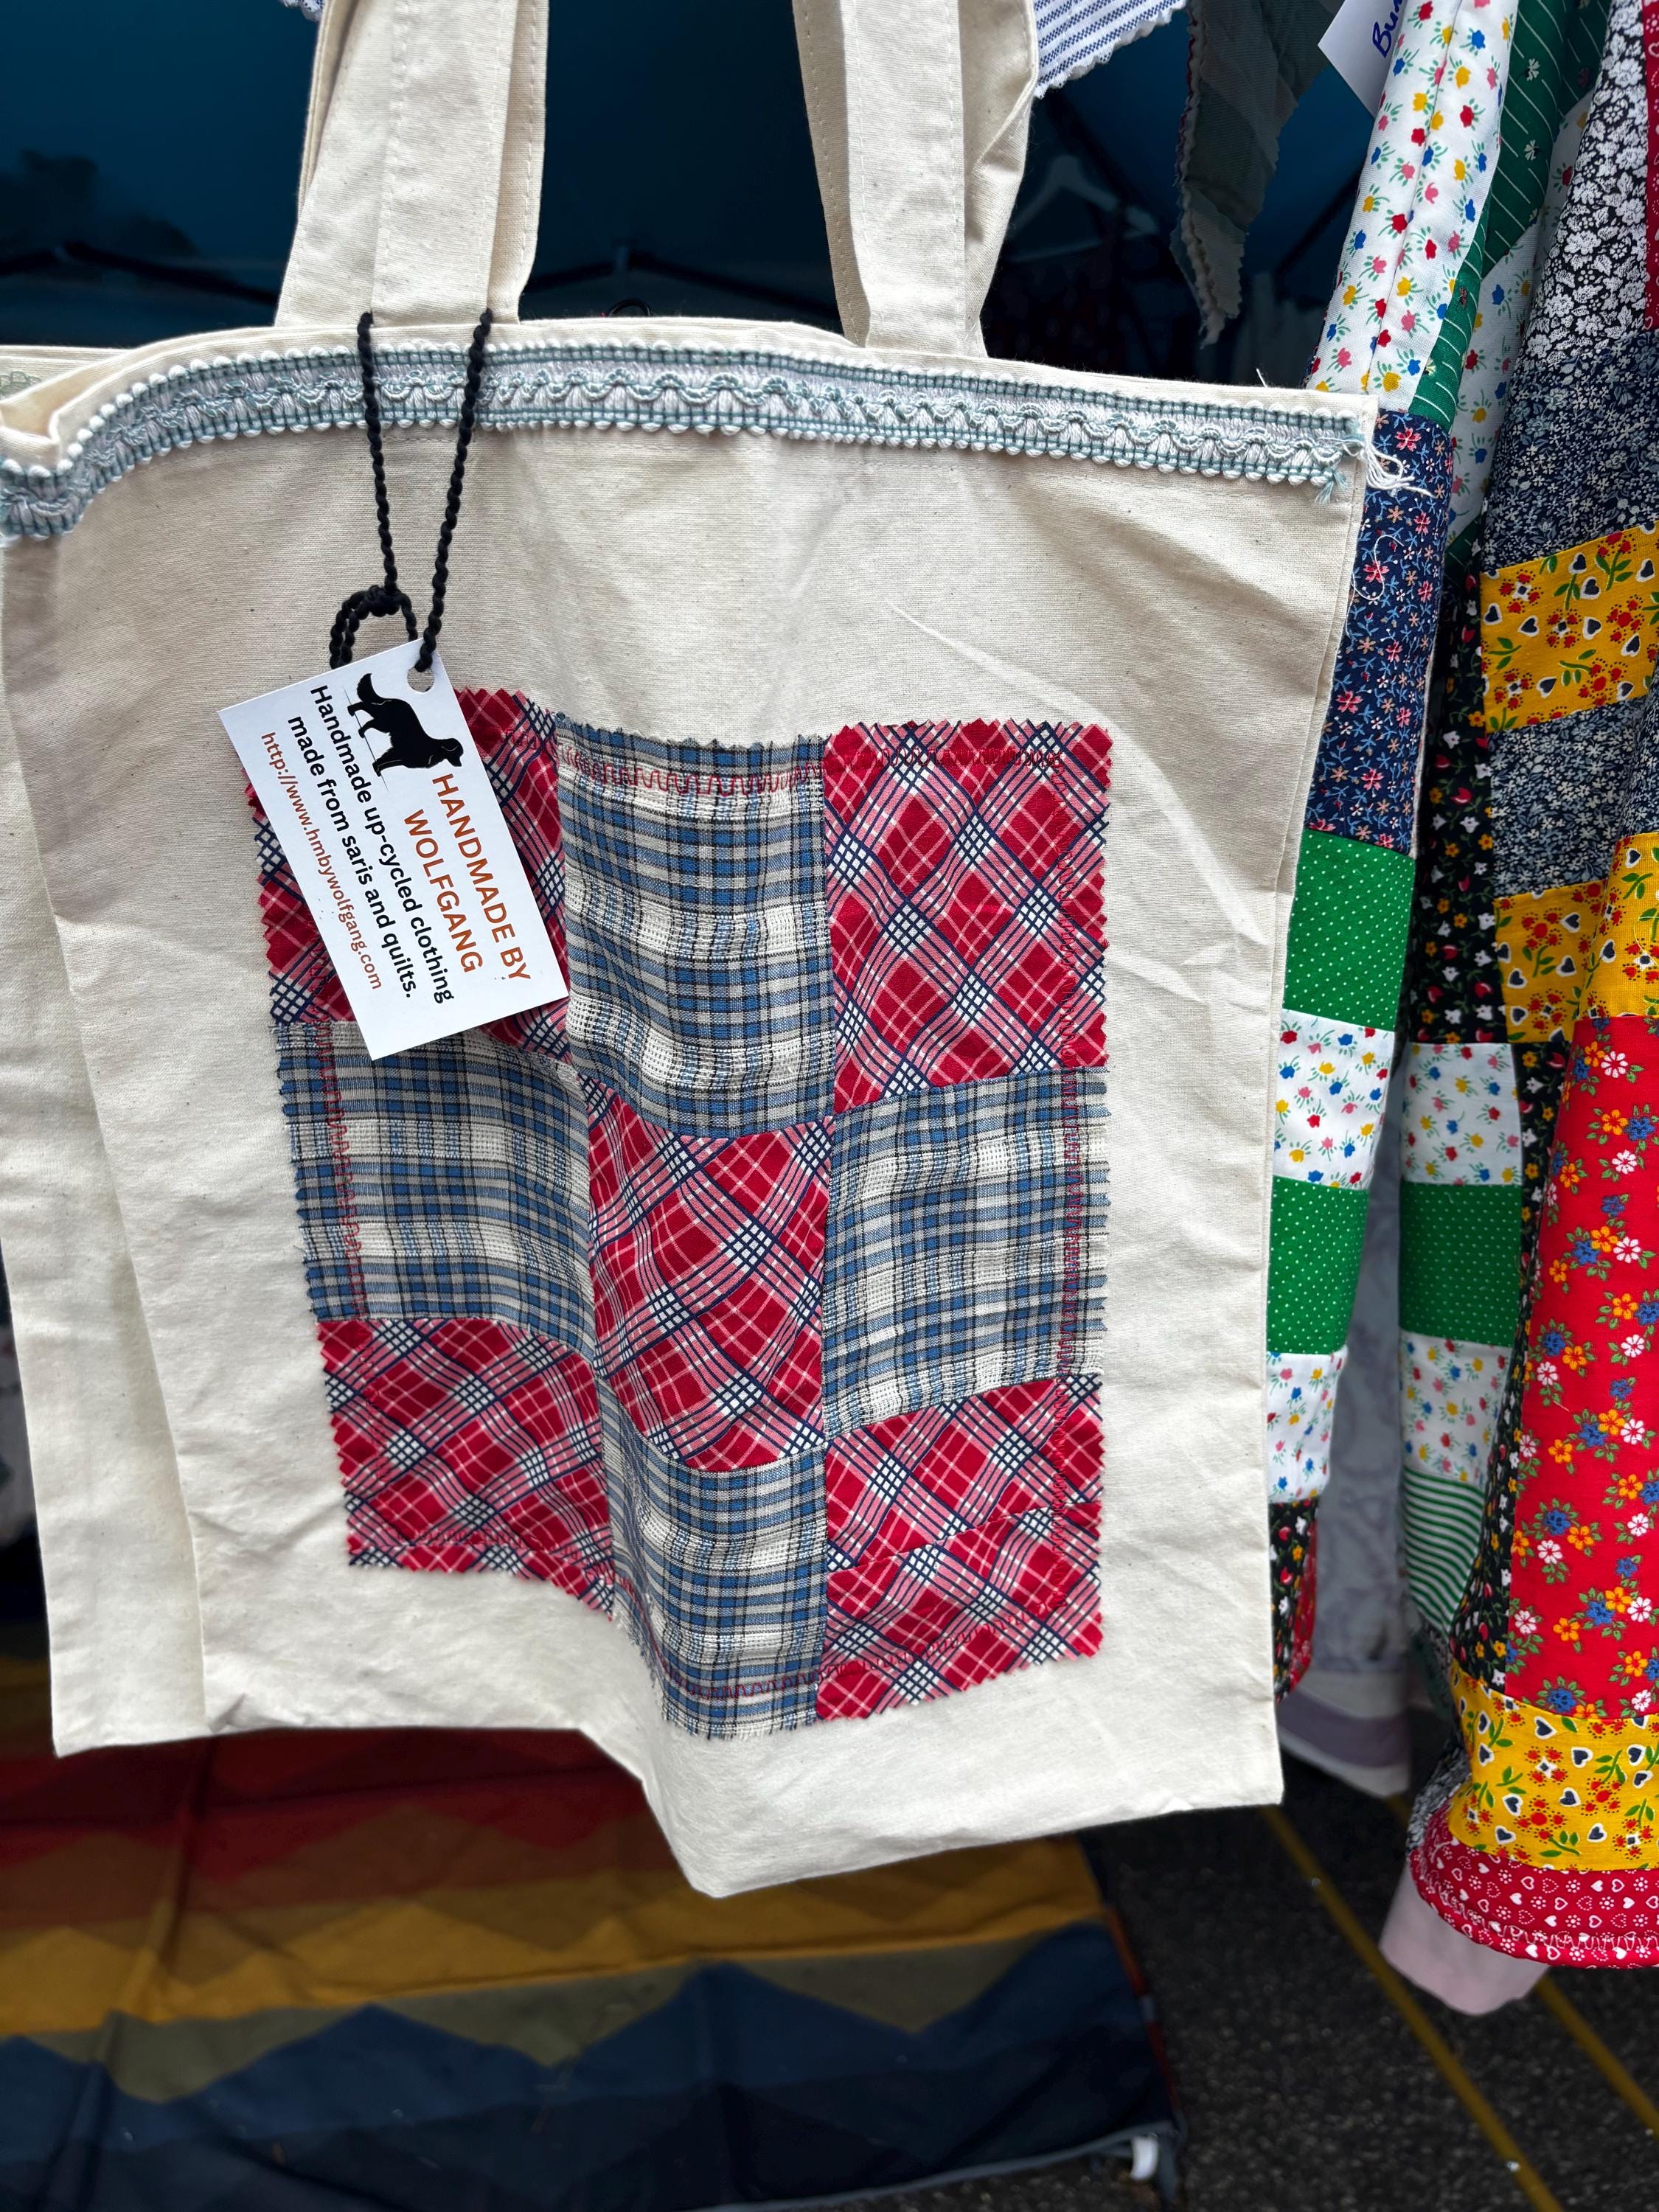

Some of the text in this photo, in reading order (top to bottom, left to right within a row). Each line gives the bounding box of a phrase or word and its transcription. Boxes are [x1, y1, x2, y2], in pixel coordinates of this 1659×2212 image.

[261, 731, 382, 990] http://www.hmbywolfgang.com
[287, 716, 417, 998] made from saris and quilts.
[310, 684, 455, 1004] Handmade up-cycled clothing
[403, 808, 483, 973] WOLFGANG
[431, 773, 532, 980] HANDMADE BY
